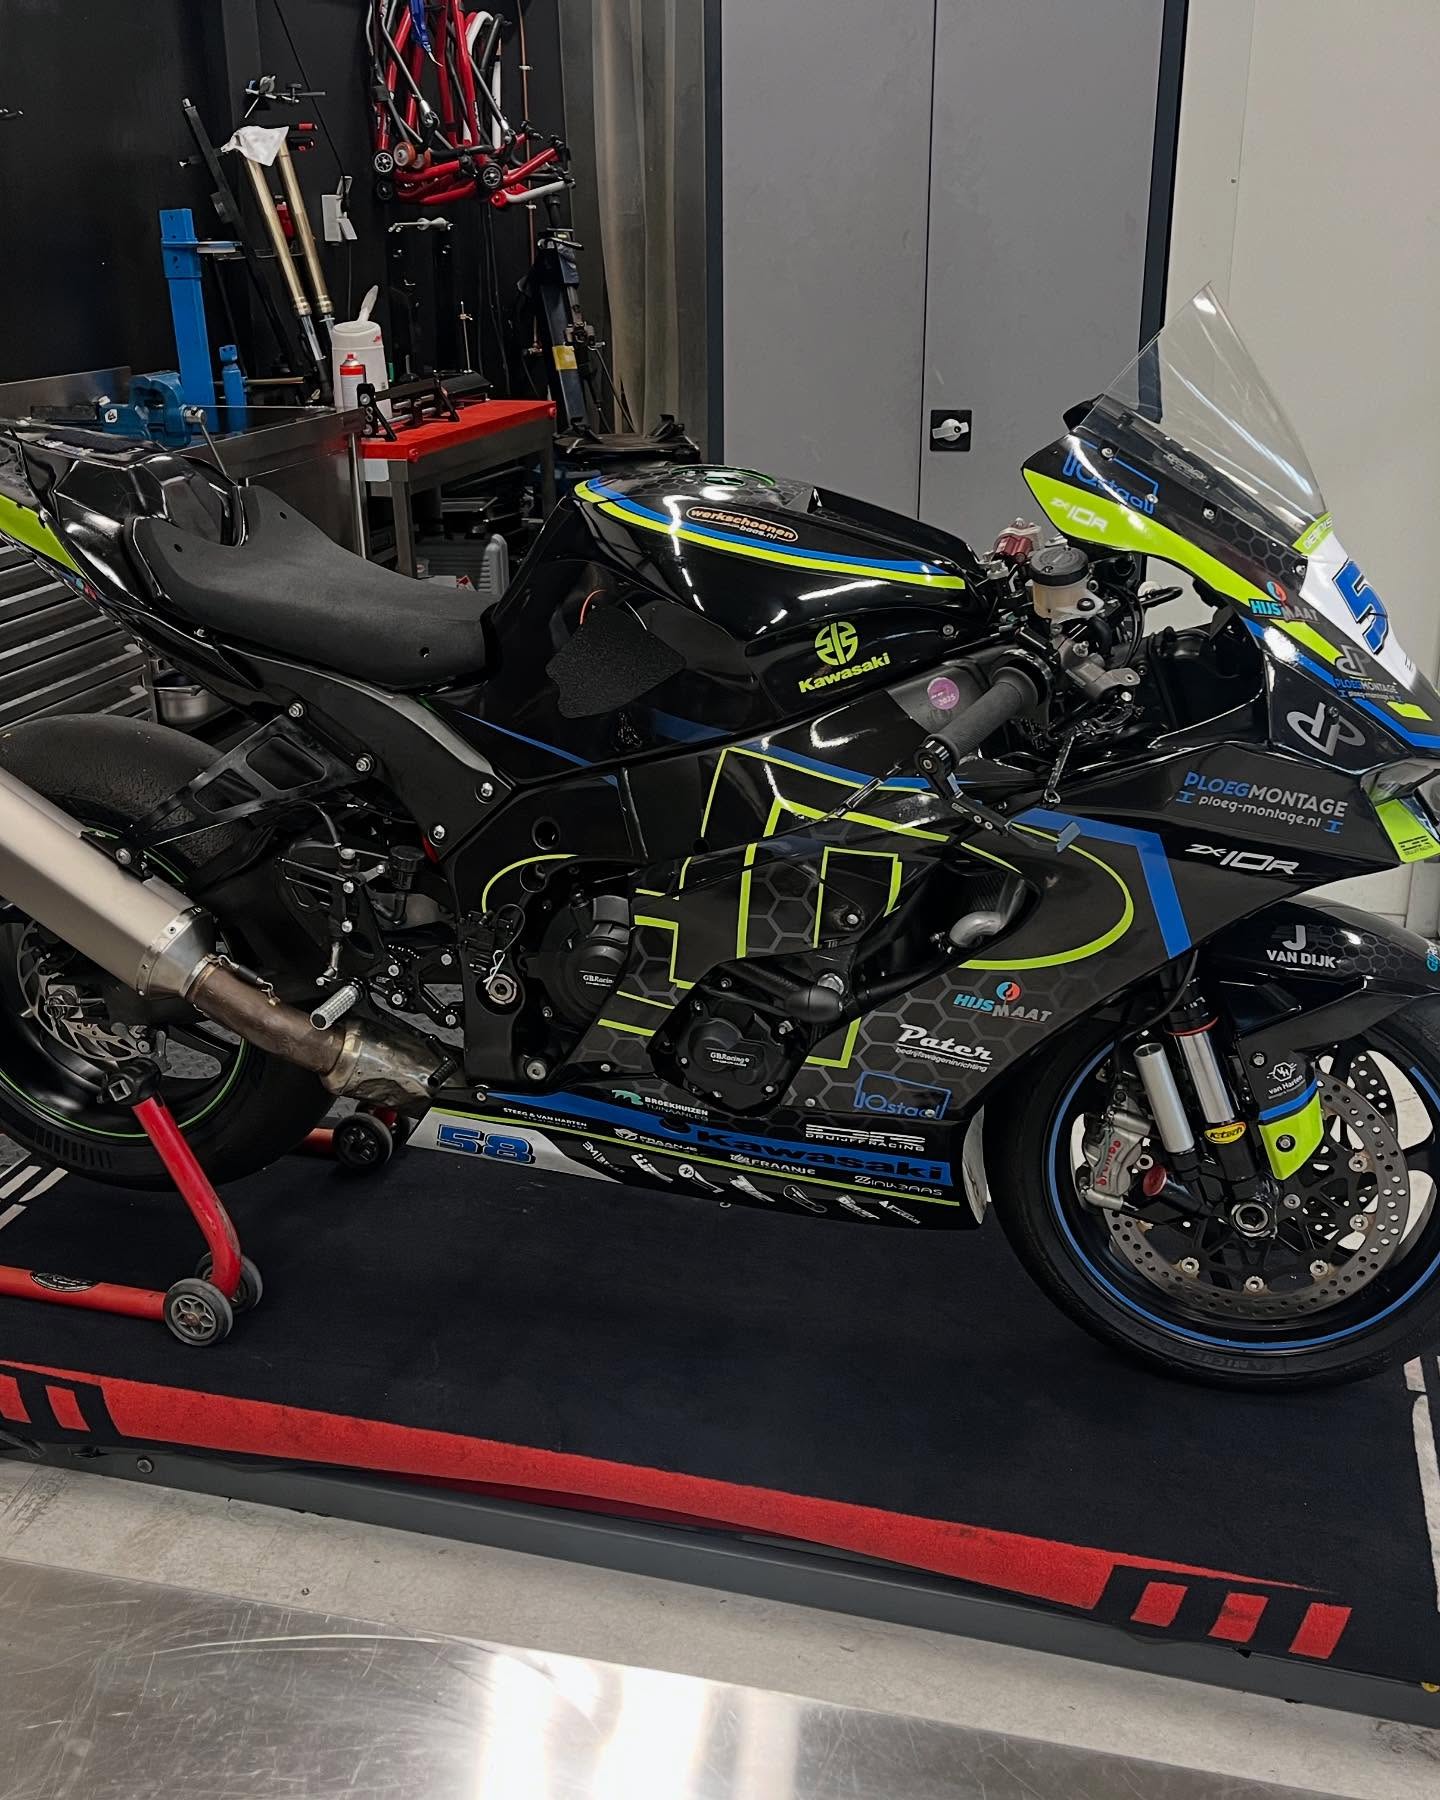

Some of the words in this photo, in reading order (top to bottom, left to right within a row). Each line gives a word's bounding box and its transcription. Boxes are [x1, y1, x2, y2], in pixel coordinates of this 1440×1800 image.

[691, 509, 795, 539] werkschoenen
[798, 652, 891, 693] Kawasaki
[1184, 771, 1348, 818] PLOEGMONTAGE
[1199, 795, 1321, 828] ploeg-montage.nl
[1267, 950, 1299, 965] VAN
[1301, 953, 1336, 969] DIJK
[583, 974, 614, 984] GBRacin
[899, 1023, 993, 1061] Pater
[644, 1096, 709, 1116] BROEKHUIZEN
[437, 1124, 536, 1164] 58
[697, 1130, 943, 1179] Kawasaki
